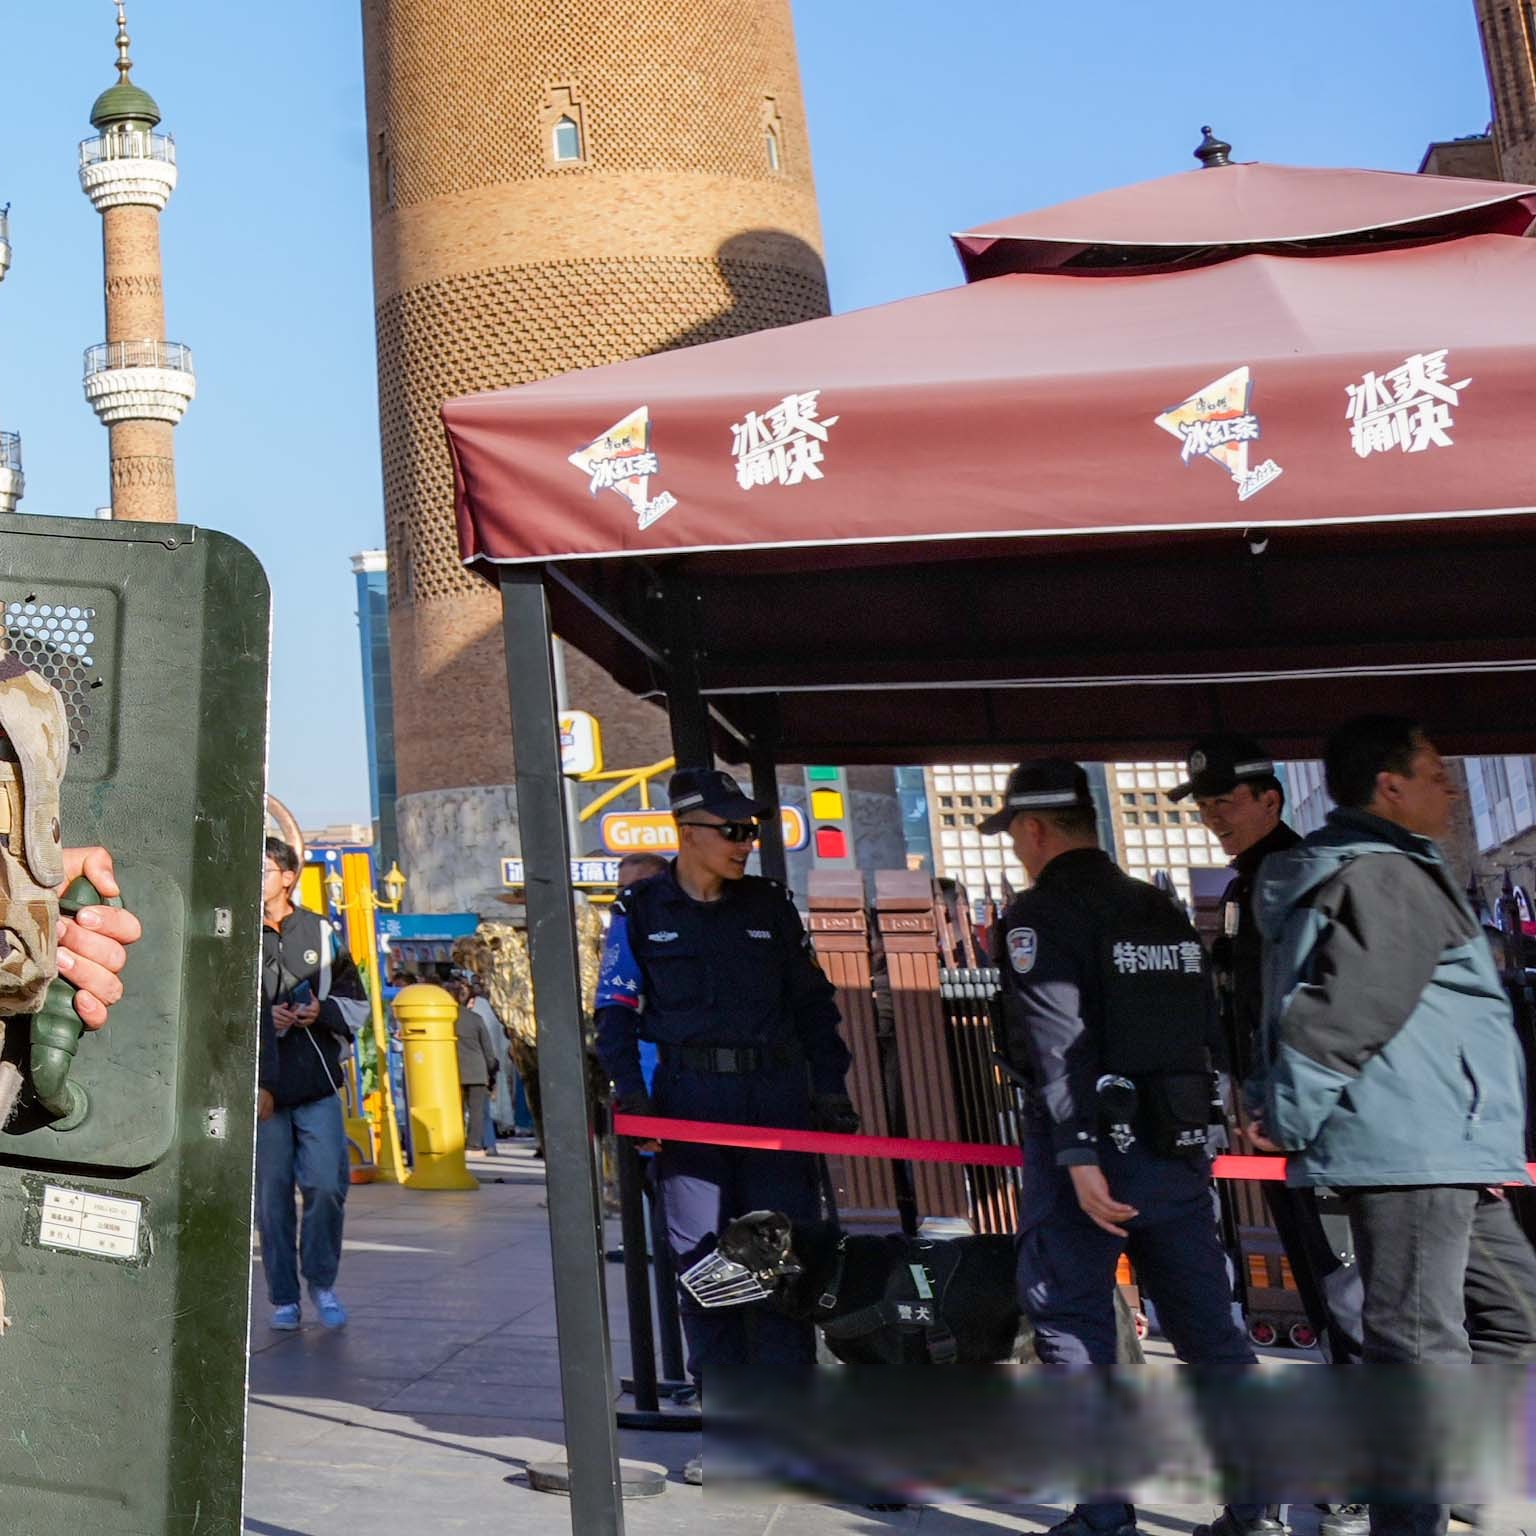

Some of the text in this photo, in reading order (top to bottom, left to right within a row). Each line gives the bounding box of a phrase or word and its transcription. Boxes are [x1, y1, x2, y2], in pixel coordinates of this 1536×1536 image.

[1345, 349, 1472, 418] 冰爽
[730, 390, 839, 456] 冰爽
[1180, 415, 1260, 463] 冰红茶
[1350, 402, 1454, 458] 痛快
[589, 452, 658, 495] 冰红茶
[735, 438, 825, 490] 痛快
[897, 1304, 931, 1320] 警犬
